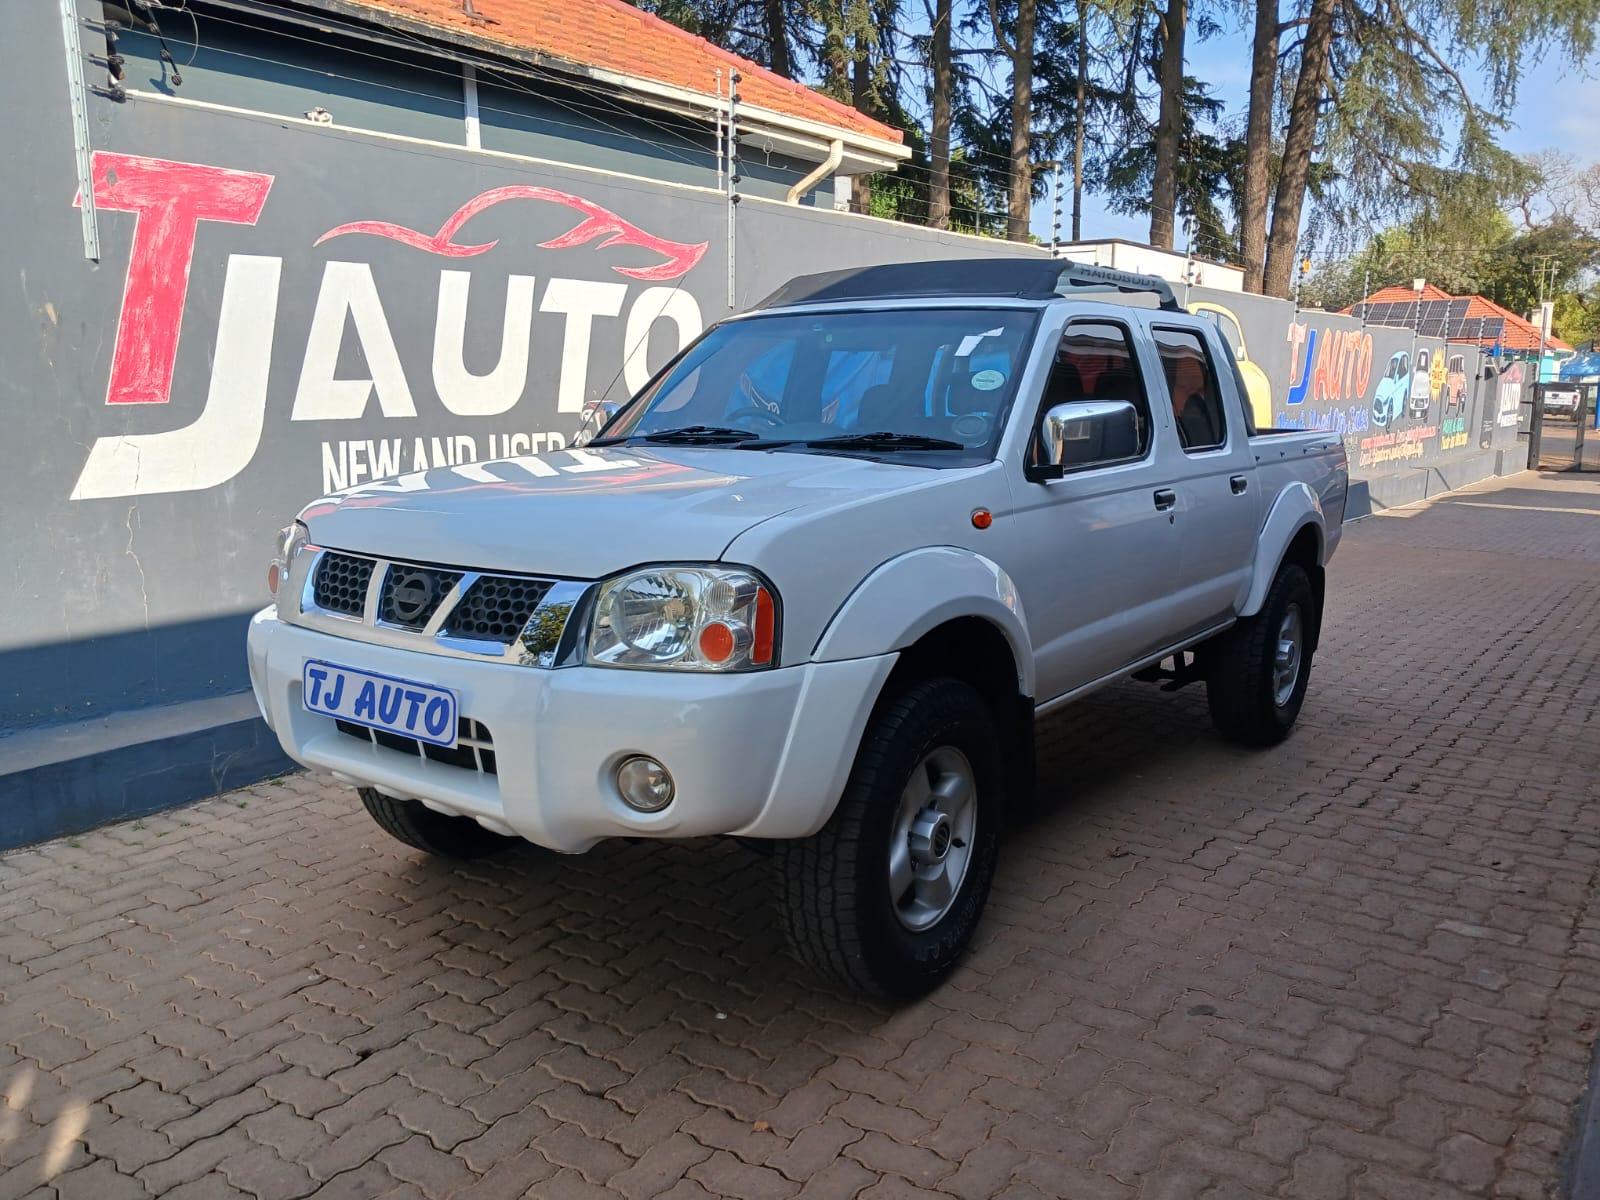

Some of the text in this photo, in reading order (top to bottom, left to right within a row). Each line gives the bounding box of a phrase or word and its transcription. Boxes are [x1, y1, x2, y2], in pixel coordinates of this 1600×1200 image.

[70, 150, 703, 500] TJ AUTO
[1287, 323, 1373, 405] TJ AUTO
[321, 438, 402, 496] NEW
[413, 435, 477, 471] AND
[309, 668, 450, 736] TJ AUTO
